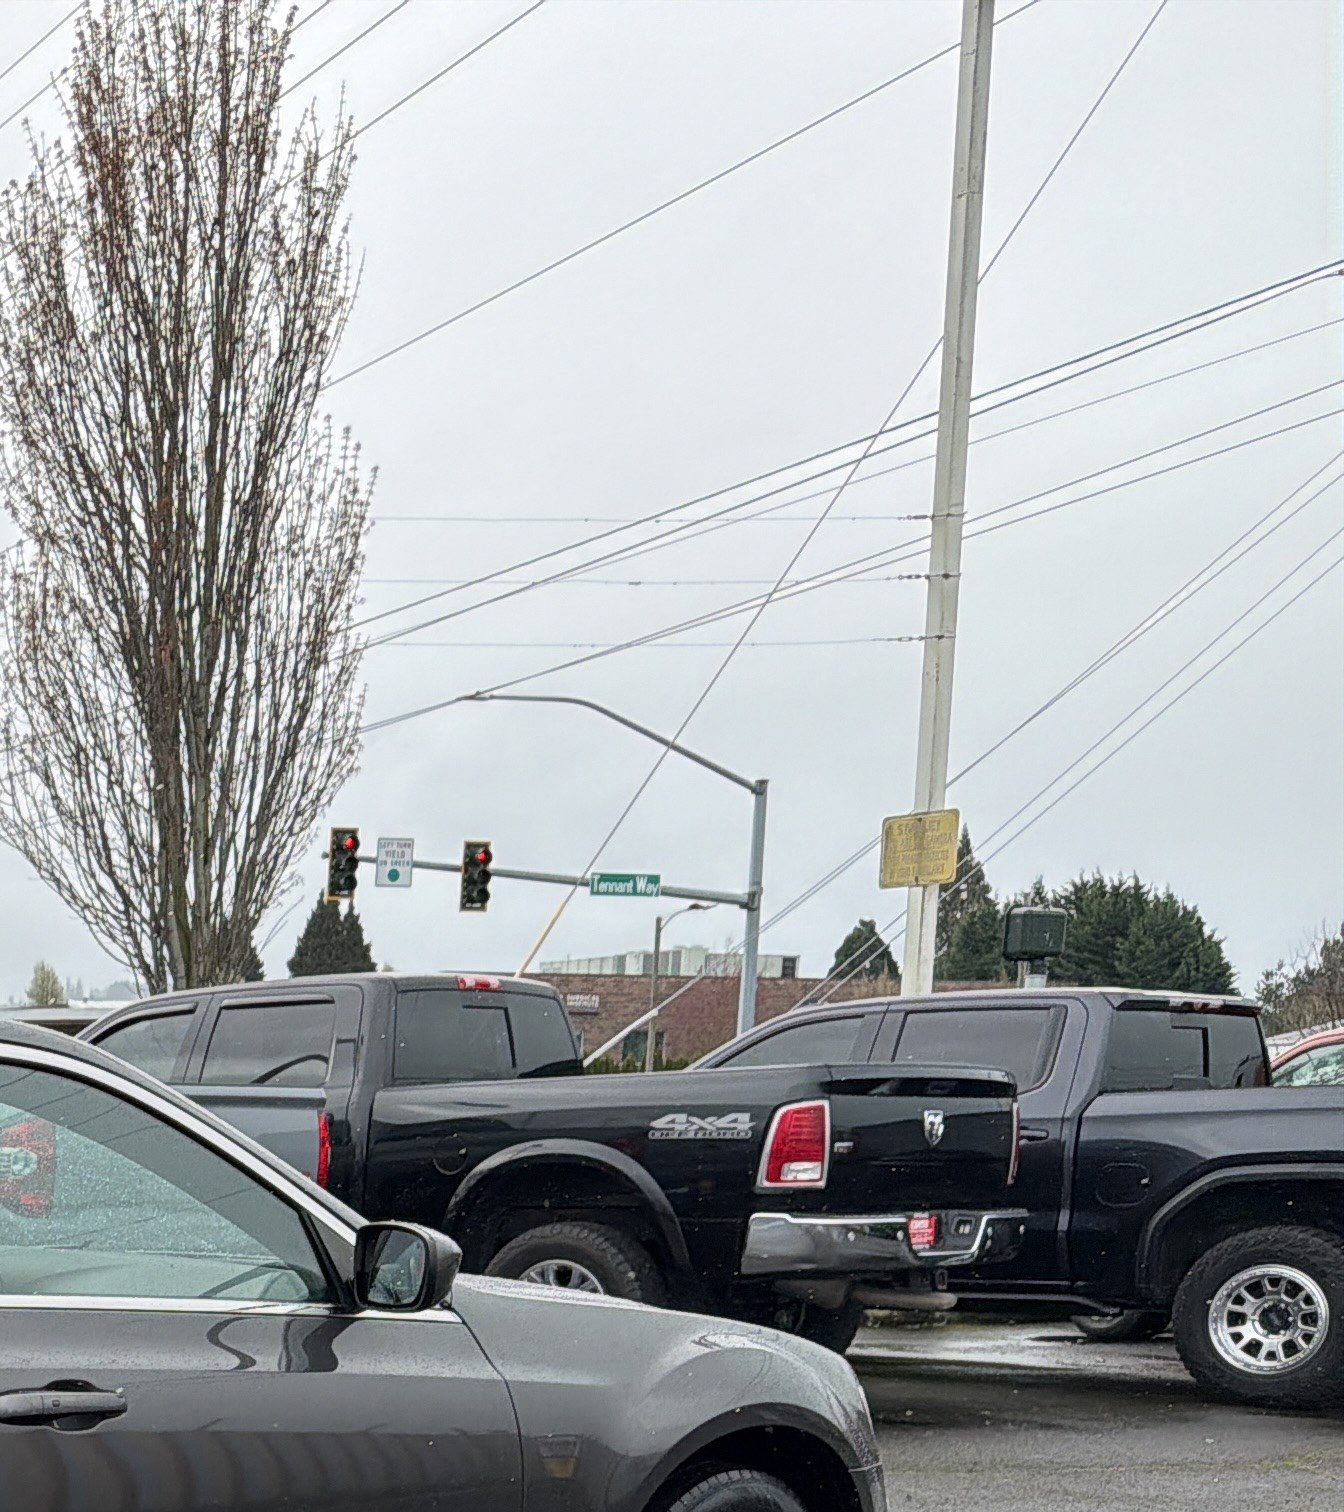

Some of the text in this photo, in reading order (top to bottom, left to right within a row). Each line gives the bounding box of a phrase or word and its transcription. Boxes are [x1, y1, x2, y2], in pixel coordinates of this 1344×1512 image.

[385, 850, 406, 858] YIELD
[593, 875, 659, 897] Tennant Way
